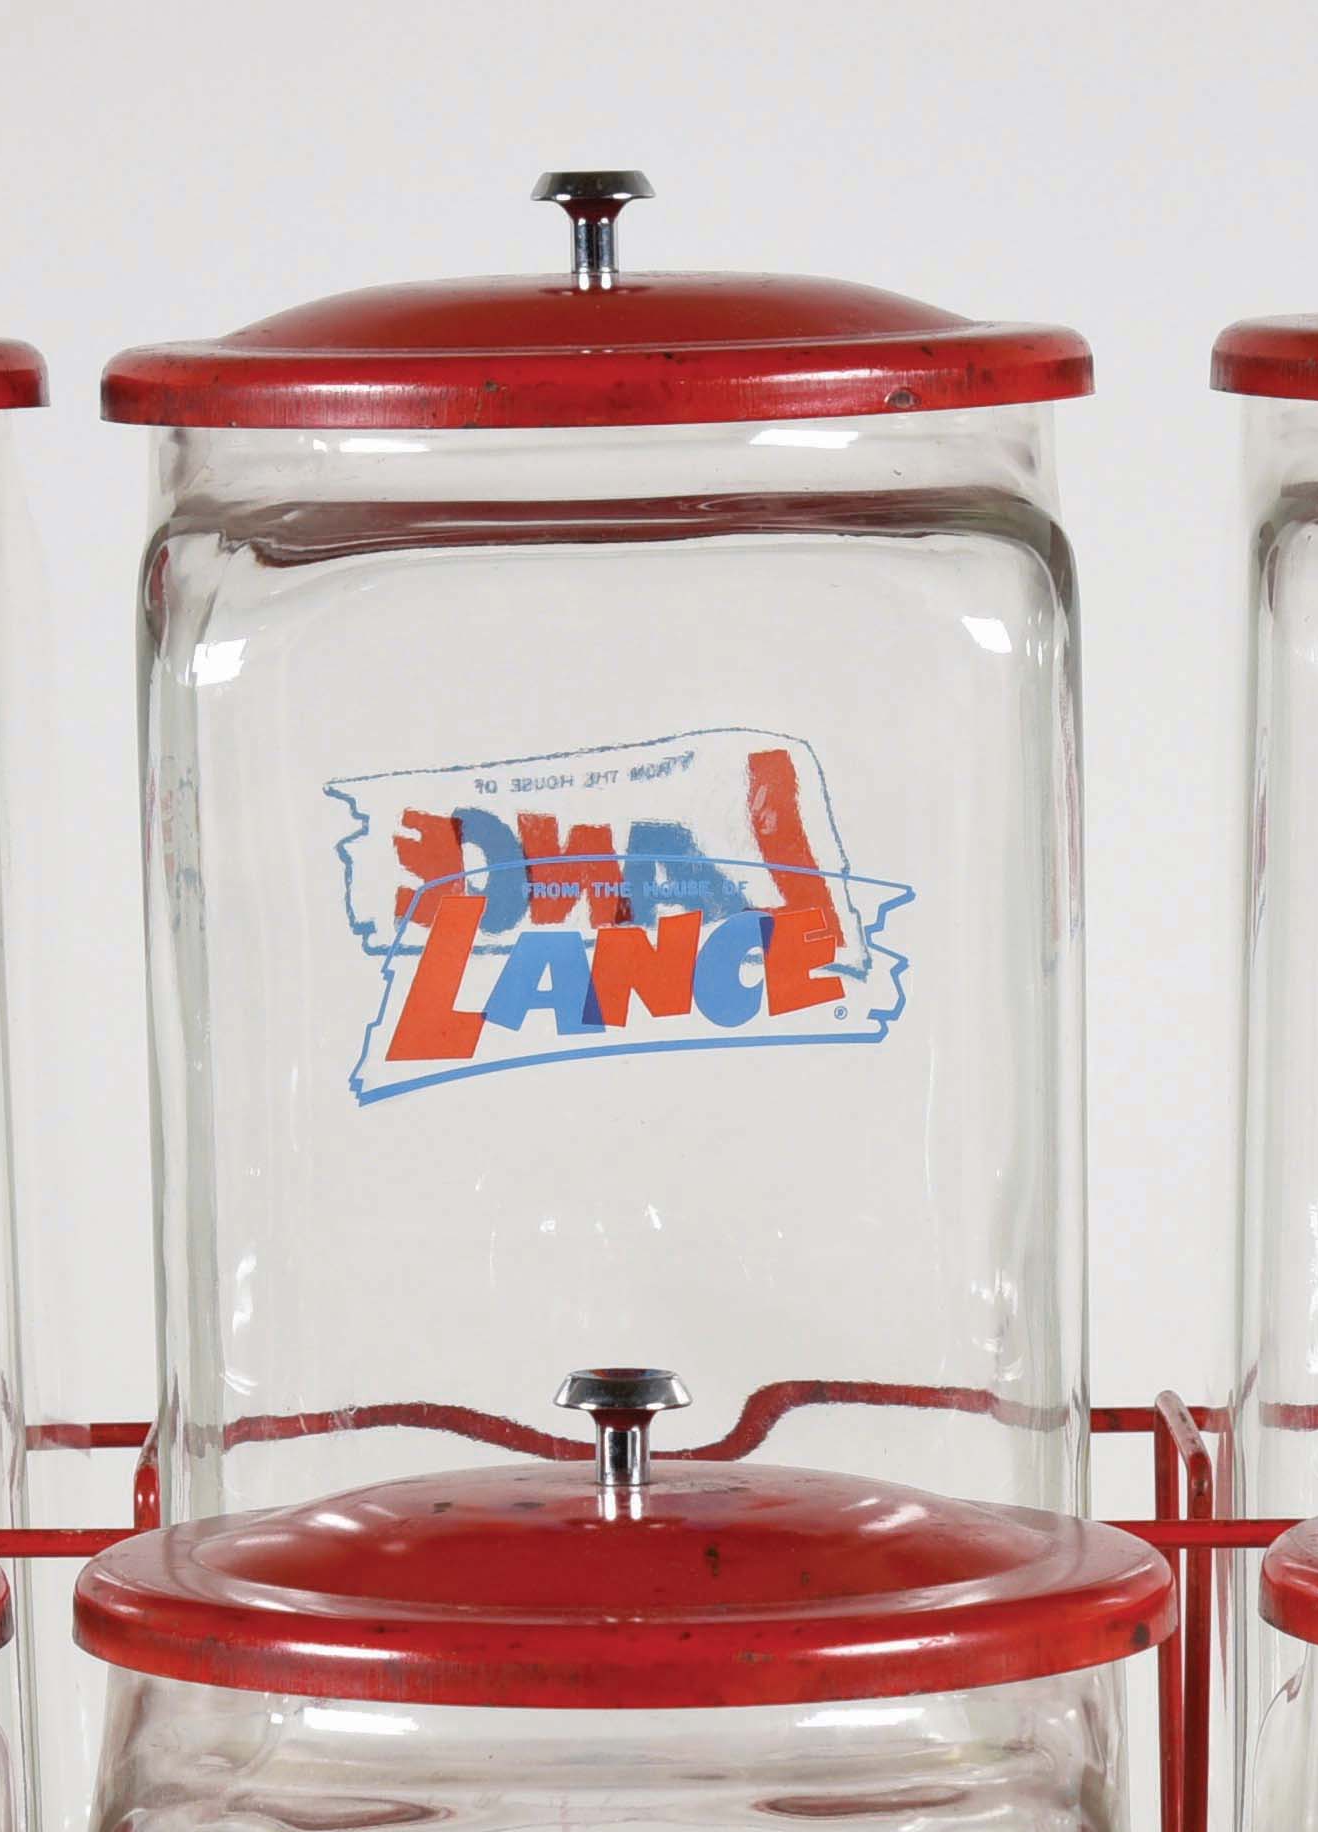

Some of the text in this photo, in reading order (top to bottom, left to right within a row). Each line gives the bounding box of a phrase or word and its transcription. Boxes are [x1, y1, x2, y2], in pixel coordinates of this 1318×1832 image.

[522, 881, 580, 898] FROM
[591, 881, 632, 898] THE
[722, 881, 748, 898] OF
[385, 896, 846, 1062] LANCE
